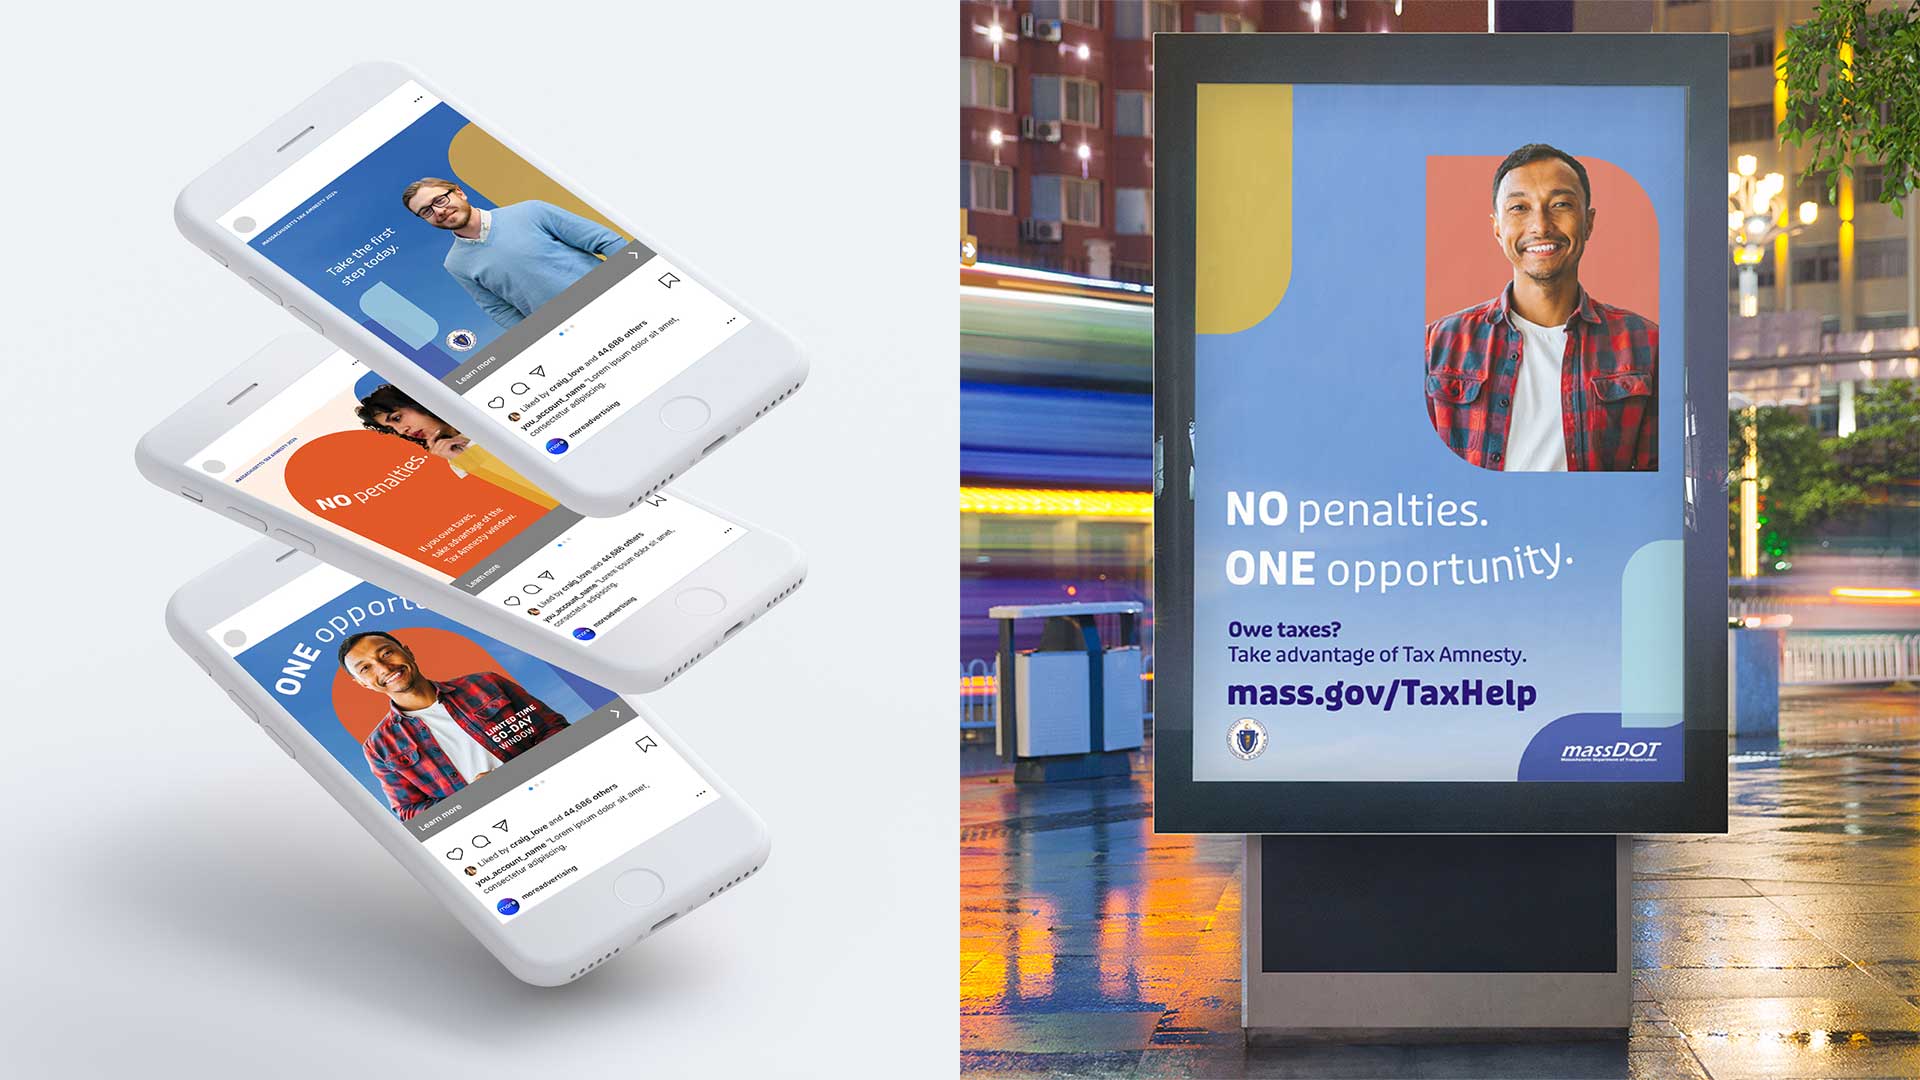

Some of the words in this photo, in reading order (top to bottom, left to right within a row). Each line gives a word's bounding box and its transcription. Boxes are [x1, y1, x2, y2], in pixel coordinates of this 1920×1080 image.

[326, 257, 355, 276] Take
[352, 244, 373, 258] the
[370, 227, 396, 245] first
[342, 268, 366, 286] step
[364, 245, 399, 268] today.
[456, 369, 478, 384] Learn
[477, 356, 496, 371] more
[520, 397, 540, 413] Liked
[539, 390, 550, 401] by
[550, 365, 585, 392] craig_love
[584, 355, 599, 367] and
[598, 336, 624, 357] 44,686
[624, 320, 647, 338] others
[521, 383, 586, 432] you_account_name
[609, 350, 632, 367] ipsum
[630, 337, 649, 352] dolor
[649, 330, 659, 339] sit
[659, 318, 680, 332] amet,
[530, 407, 570, 437] consectetur
[569, 382, 607, 409] adipiscing.
[569, 400, 620, 438] moreadvertising
[316, 494, 352, 511] NO
[354, 456, 428, 503] penalties.
[425, 539, 440, 549] you
[439, 528, 455, 539] owe
[452, 513, 476, 528] taxes,
[1227, 491, 1287, 526] NO
[1300, 493, 1488, 532] penalties.
[432, 546, 450, 558] take
[448, 522, 484, 547] advantage
[482, 515, 491, 523] of
[488, 507, 503, 517] the
[444, 554, 460, 564] Tax
[457, 533, 488, 556] Amnesty
[486, 514, 517, 535] window.
[466, 574, 485, 588] Learn
[484, 564, 501, 576] more
[537, 594, 555, 609] Liked
[554, 590, 563, 600] by
[562, 568, 592, 592] craig_love
[591, 561, 603, 571] and
[624, 532, 644, 547] others
[543, 582, 598, 623] you_account_name
[615, 556, 635, 570] ipsum
[633, 545, 650, 558] dolor
[1226, 550, 1315, 586] ONE
[1327, 542, 1573, 592] opportunity.
[554, 601, 588, 628] consectetur
[593, 595, 637, 628] moreadvertising
[1229, 622, 1272, 638] Owe
[1278, 622, 1341, 638] taxes?
[275, 642, 321, 695] ONE
[1229, 647, 1272, 662] Take
[1276, 647, 1374, 666] advantage
[1380, 646, 1398, 662] of
[1403, 647, 1434, 662] Tax
[1439, 647, 1527, 666] Amnesty.
[1228, 680, 1536, 711] mass.gov/TaxHelp
[485, 716, 516, 736] LIMITED
[516, 704, 536, 718] TIME
[492, 716, 532, 743] 60-DAY
[499, 727, 535, 750] WINDOW
[1562, 742, 1662, 757] massDOT
[418, 814, 442, 831] Learn
[441, 804, 462, 818] more
[475, 843, 547, 887] you_account_name
[574, 813, 597, 829] ipsum
[597, 802, 617, 815] dolor
[617, 795, 628, 804] sit
[627, 783, 650, 797] amet,
[477, 853, 499, 867] Liked
[498, 847, 510, 856] by
[510, 823, 549, 849] craig_love
[548, 815, 563, 825] and
[563, 798, 592, 817] 44,686
[592, 782, 618, 800] others
[483, 865, 527, 894] consectetur
[527, 844, 568, 868] adipiscing.
[521, 865, 578, 900] moreadvertising
